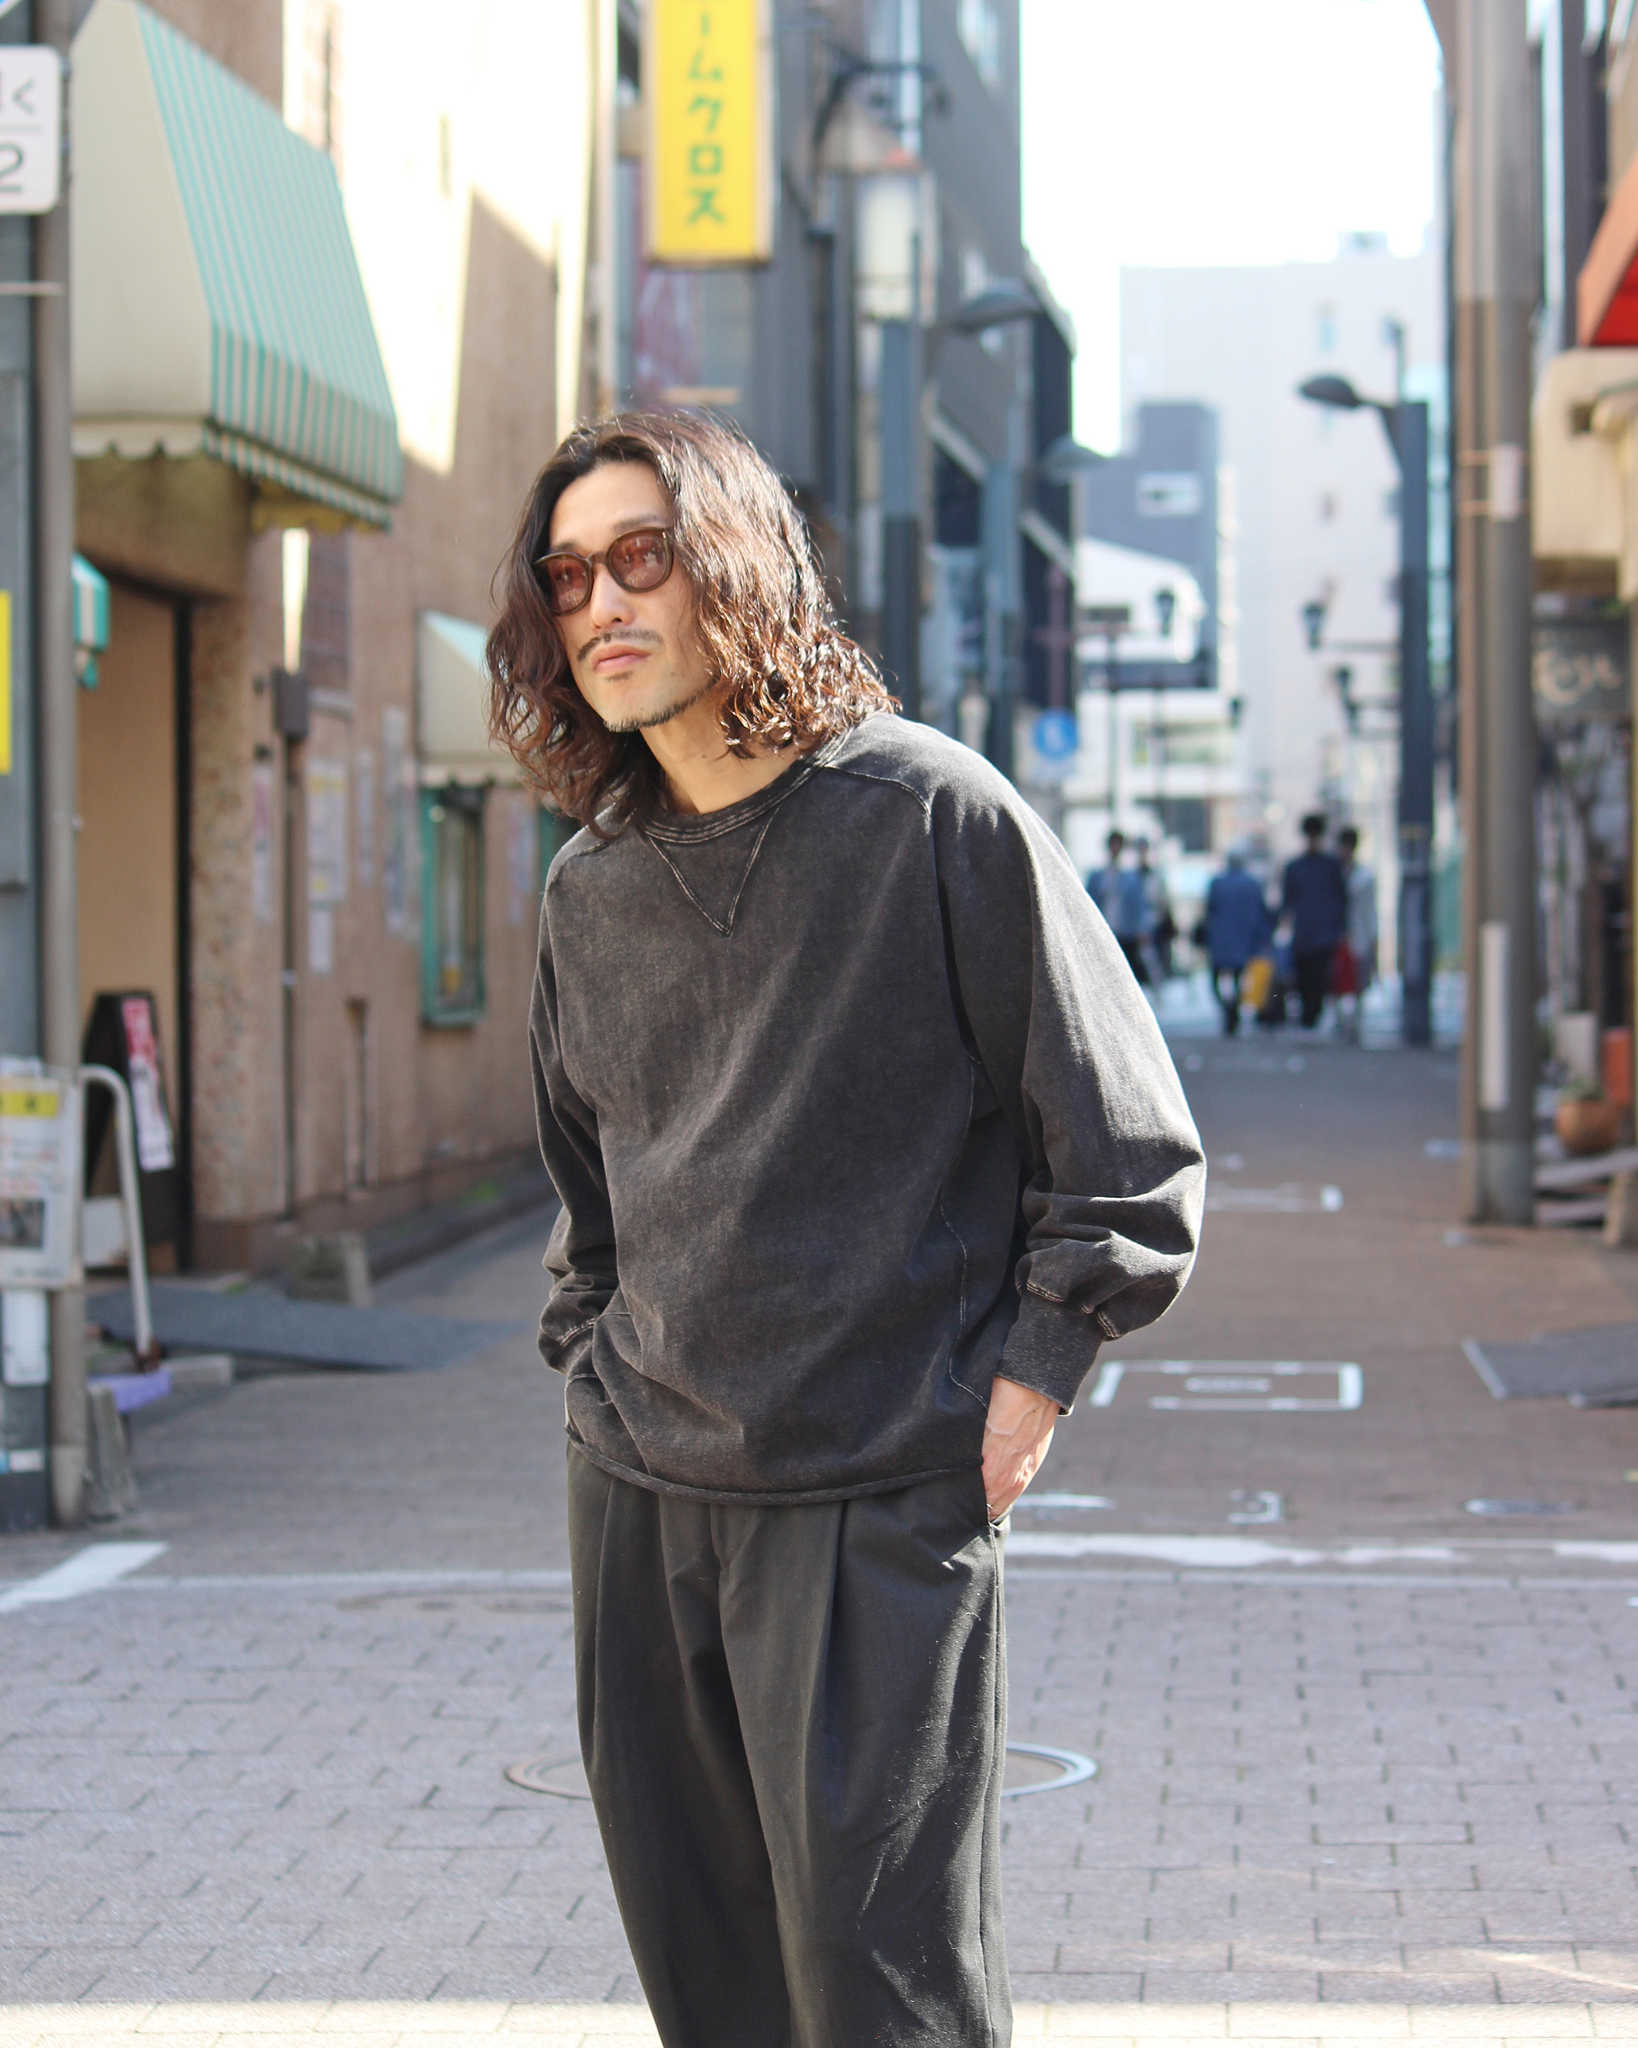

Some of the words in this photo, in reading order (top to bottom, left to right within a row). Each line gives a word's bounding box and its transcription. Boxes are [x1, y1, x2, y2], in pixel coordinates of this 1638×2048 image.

[686, 9, 727, 227] ームクロス
